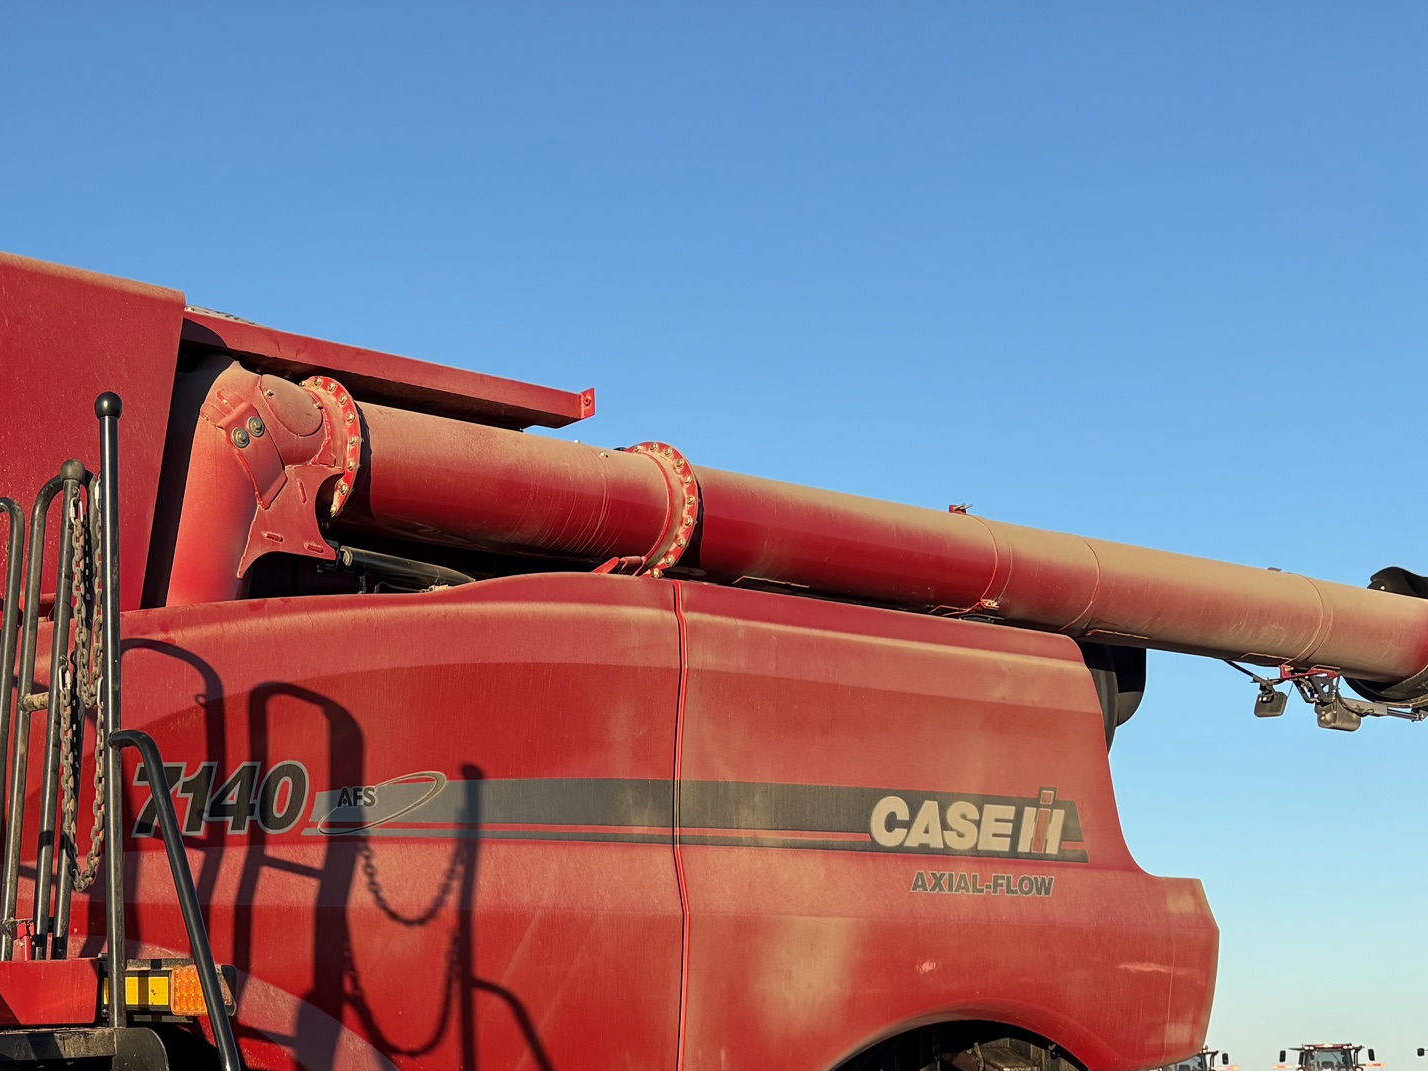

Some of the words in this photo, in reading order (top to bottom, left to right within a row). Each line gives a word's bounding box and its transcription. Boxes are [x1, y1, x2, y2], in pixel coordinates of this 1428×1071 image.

[337, 786, 376, 807] AFS
[870, 796, 1015, 851] CASE
[910, 870, 1054, 897] AXIAL-FLOW
